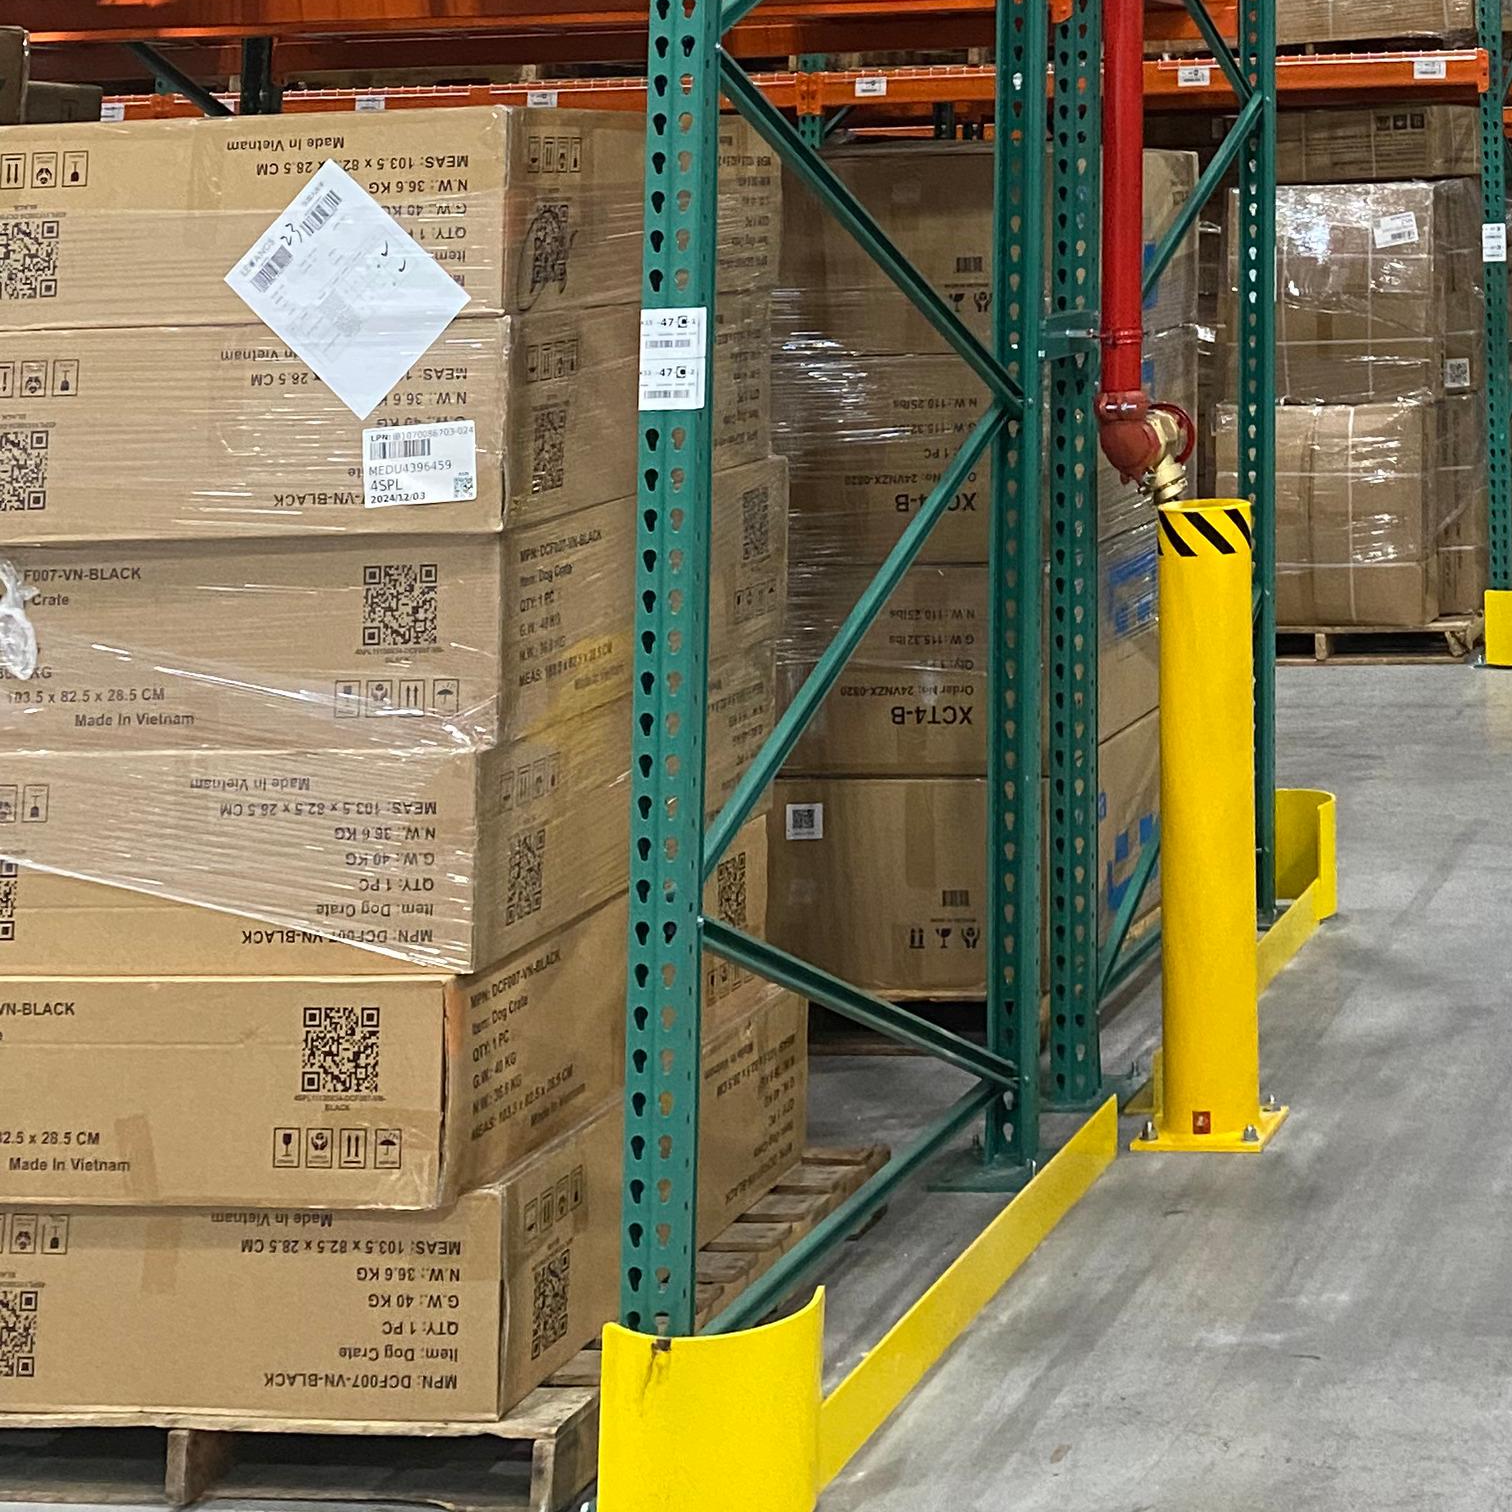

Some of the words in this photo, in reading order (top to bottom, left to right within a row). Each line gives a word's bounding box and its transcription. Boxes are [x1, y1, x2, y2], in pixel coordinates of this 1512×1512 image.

[227, 139, 284, 151] Vietnam
[290, 138, 301, 150] In
[307, 137, 344, 149] Made
[284, 162, 313, 173] 28.5
[377, 157, 413, 169] 103.5
[420, 155, 469, 168] MEAS:
[257, 164, 278, 175] CM
[369, 182, 391, 193] KG
[396, 181, 425, 192] 36.6
[407, 205, 423, 215] 40
[432, 227, 466, 239] QTY:
[220, 350, 278, 361] Vietnam
[251, 374, 273, 386] CM
[279, 373, 308, 385] 28.5
[371, 492, 425, 504] 2024/12/03
[32, 594, 69, 606] Crate
[61, 690, 94, 702] 82.5
[108, 689, 137, 701] 28.5
[142, 688, 165, 700] CM
[75, 714, 112, 726] Made
[118, 715, 131, 725] In
[137, 715, 194, 725] Vietnam
[891, 706, 973, 725] XCT4-B
[190, 779, 248, 791] Vietnam
[254, 778, 266, 790] In
[272, 778, 310, 790] Made
[220, 804, 242, 816] CM
[295, 802, 324, 814] 82.5
[343, 803, 379, 814] 103.5
[388, 802, 436, 814] MEAS:
[335, 828, 356, 839] KG
[346, 853, 367, 865] KG
[373, 853, 389, 865] 40
[359, 879, 380, 891] PC
[399, 879, 433, 891] QTY:
[317, 905, 356, 917] Crate
[362, 904, 391, 916] Dog
[397, 905, 433, 916] Item:
[395, 930, 432, 942] MPN:
[29, 1134, 36, 1144] x
[41, 1131, 72, 1145] 28.5
[76, 1132, 100, 1145] CM
[9, 1157, 47, 1171] Made
[53, 1158, 65, 1171] In
[71, 1158, 130, 1171] Vietnam
[211, 1213, 270, 1226] Vietnam
[275, 1214, 288, 1226] In
[294, 1213, 332, 1227] Made
[241, 1239, 263, 1253] CM
[270, 1239, 298, 1253] 28.5
[317, 1240, 347, 1253] 82.5
[365, 1241, 404, 1254] 103.5
[411, 1241, 460, 1255] MEAS:
[357, 1267, 379, 1280] KG
[385, 1267, 415, 1281] 36.6
[368, 1294, 390, 1307] KG
[396, 1294, 414, 1308] 40
[382, 1321, 403, 1335] PC
[410, 1321, 416, 1334] 1
[422, 1321, 459, 1335] QTY:
[339, 1347, 380, 1361] Crate
[385, 1344, 415, 1361] Dog
[421, 1348, 458, 1362] Item:
[264, 1373, 411, 1388] DCF007-VN-BLACK
[418, 1374, 457, 1389] MPN:
